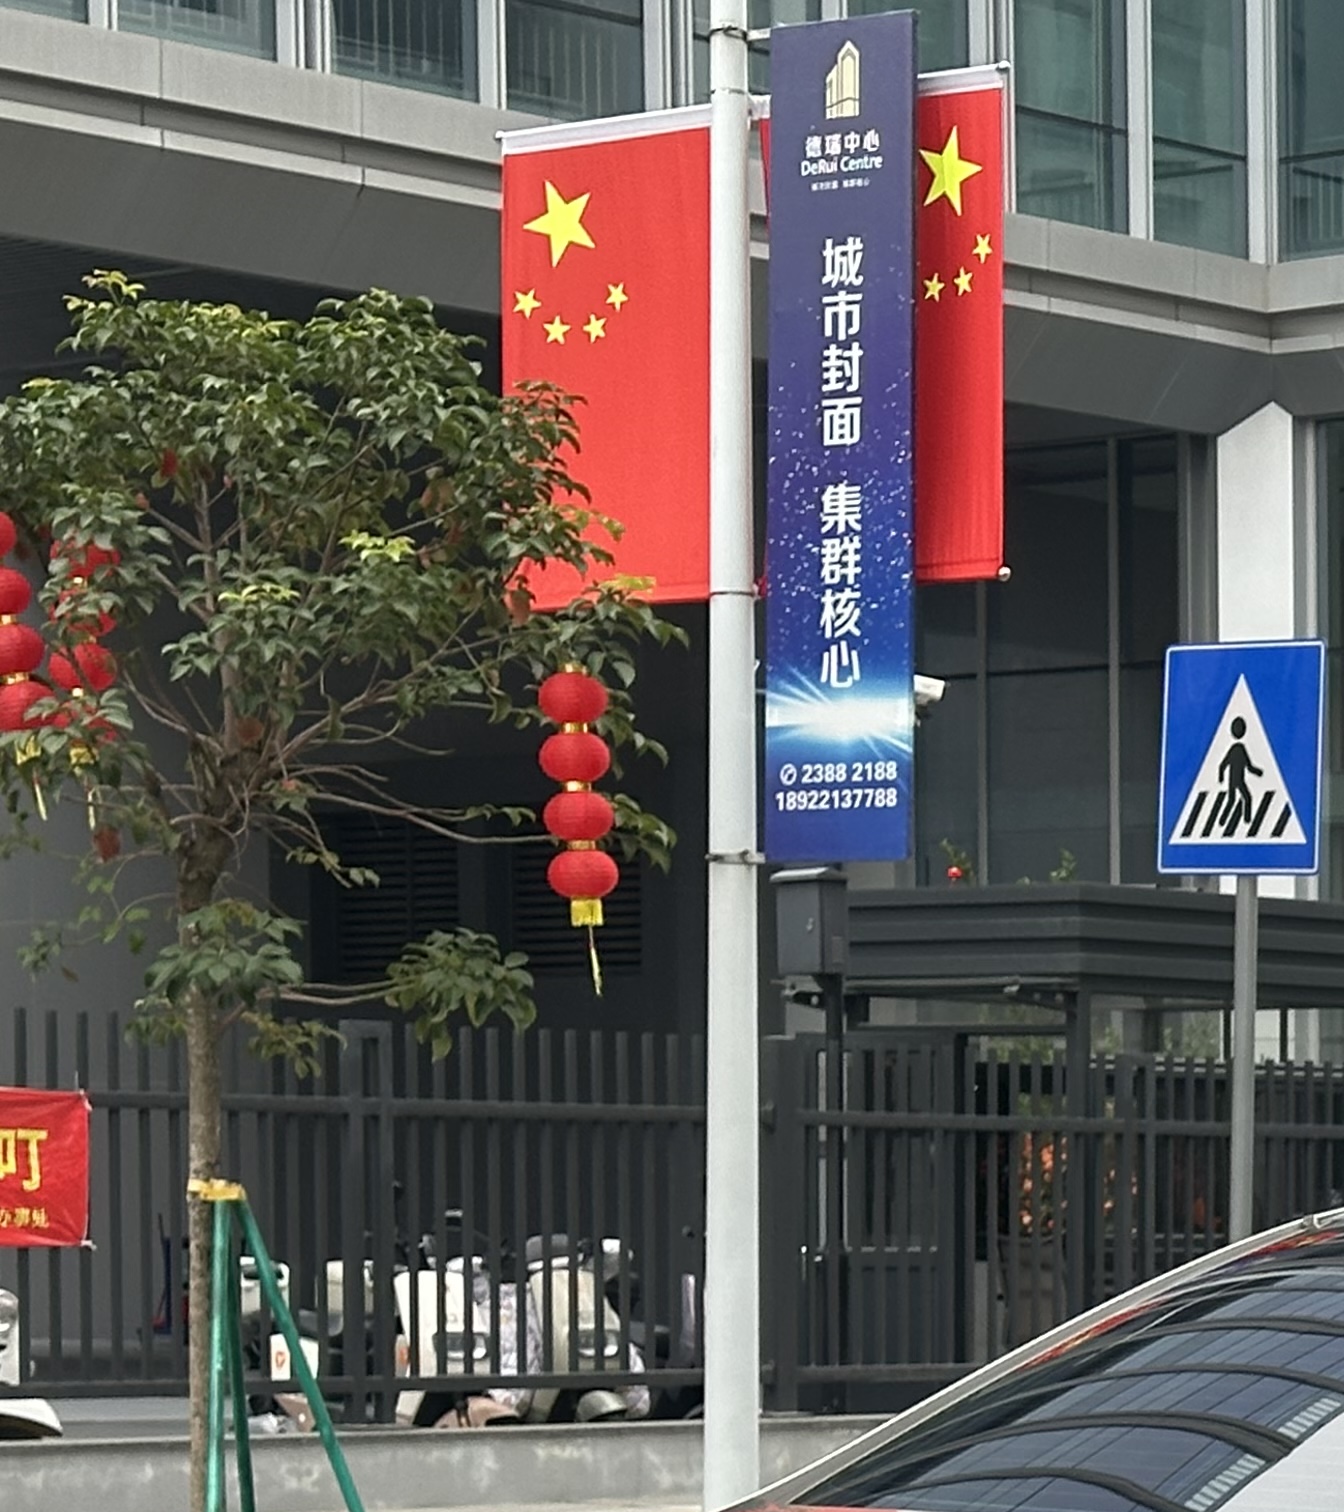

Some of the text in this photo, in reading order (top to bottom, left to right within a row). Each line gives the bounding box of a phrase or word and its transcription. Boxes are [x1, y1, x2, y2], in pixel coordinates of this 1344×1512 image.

[805, 129, 880, 159] 德瑞中心
[801, 154, 883, 177] DeRui Centre
[822, 236, 864, 448] 城市封面
[820, 483, 863, 689] 集群核心
[801, 759, 898, 785] 2388 2188
[775, 787, 898, 813] 18922137788
